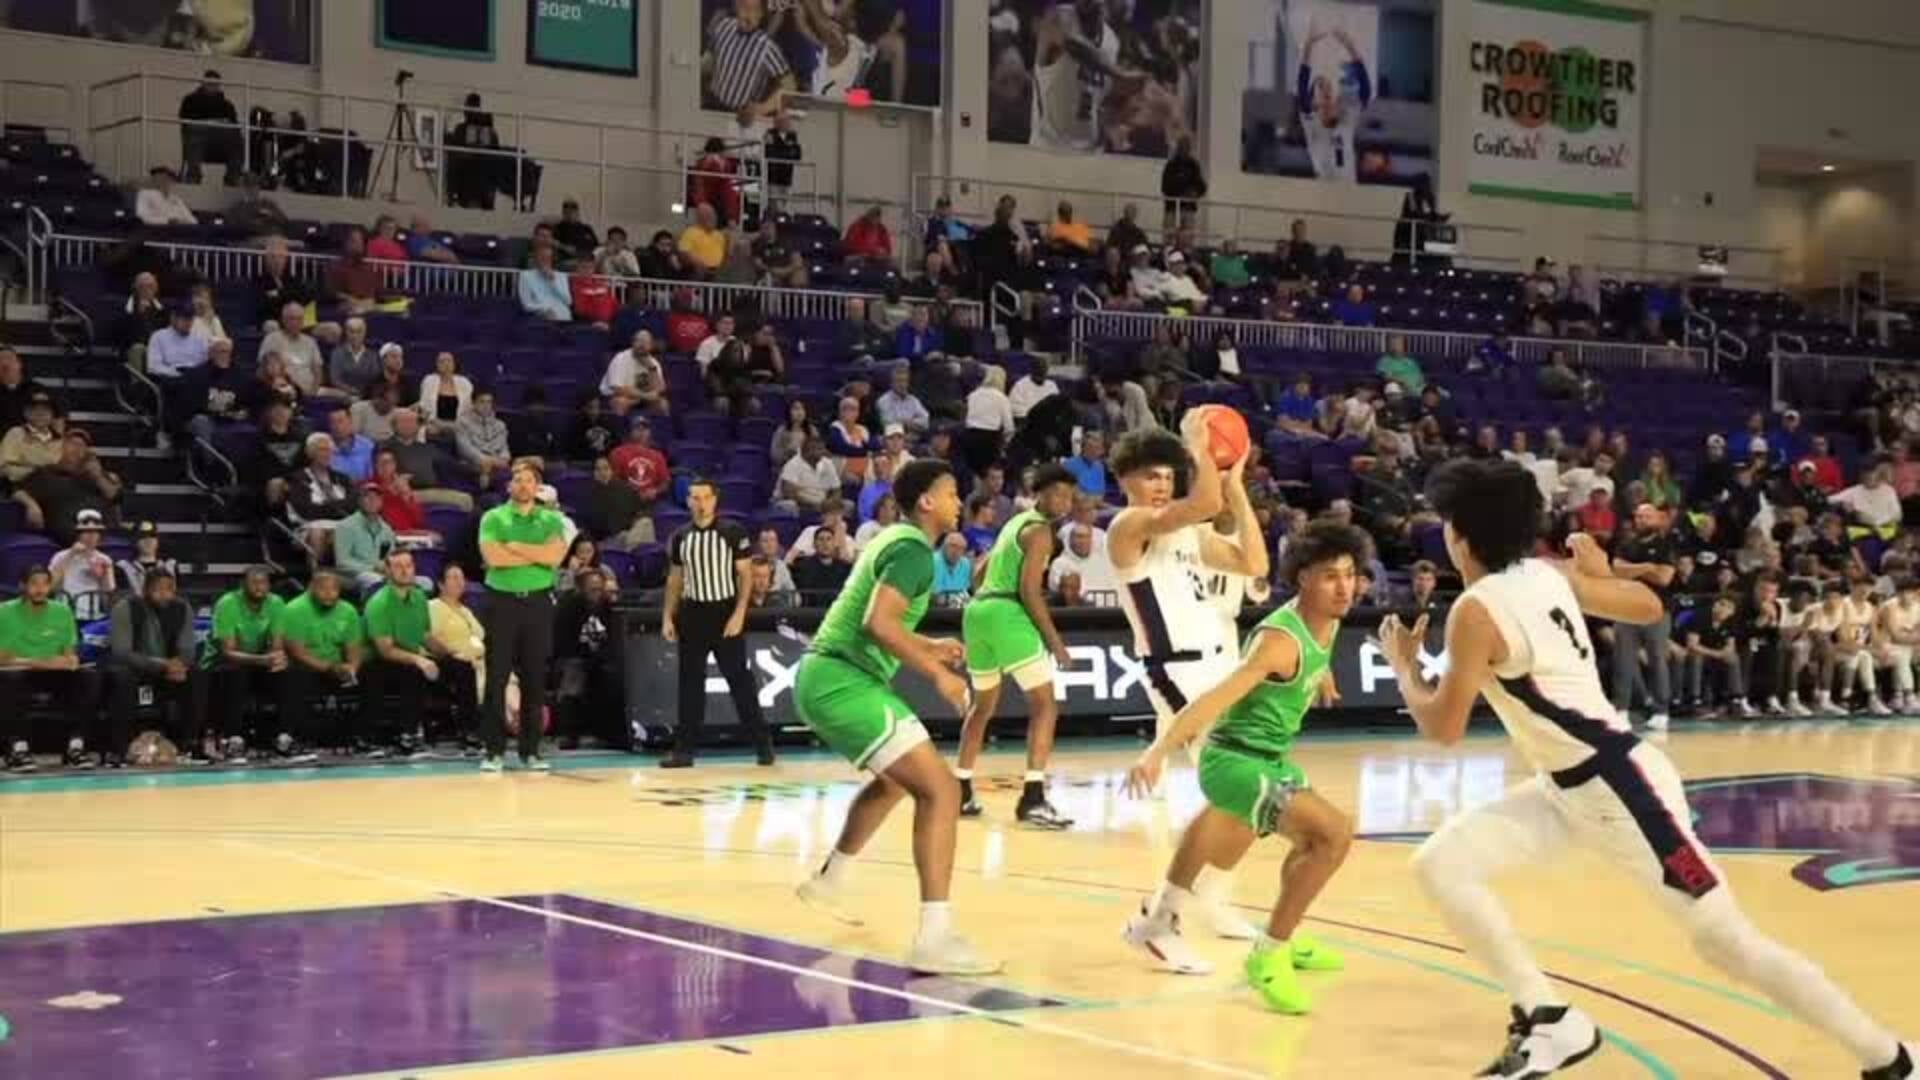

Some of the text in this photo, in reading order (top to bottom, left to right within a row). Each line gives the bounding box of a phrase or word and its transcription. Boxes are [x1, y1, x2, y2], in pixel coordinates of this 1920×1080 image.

[537, 1, 581, 20] 2020
[1470, 41, 1636, 95] CROWTHER
[1481, 82, 1618, 129] ROOFING
